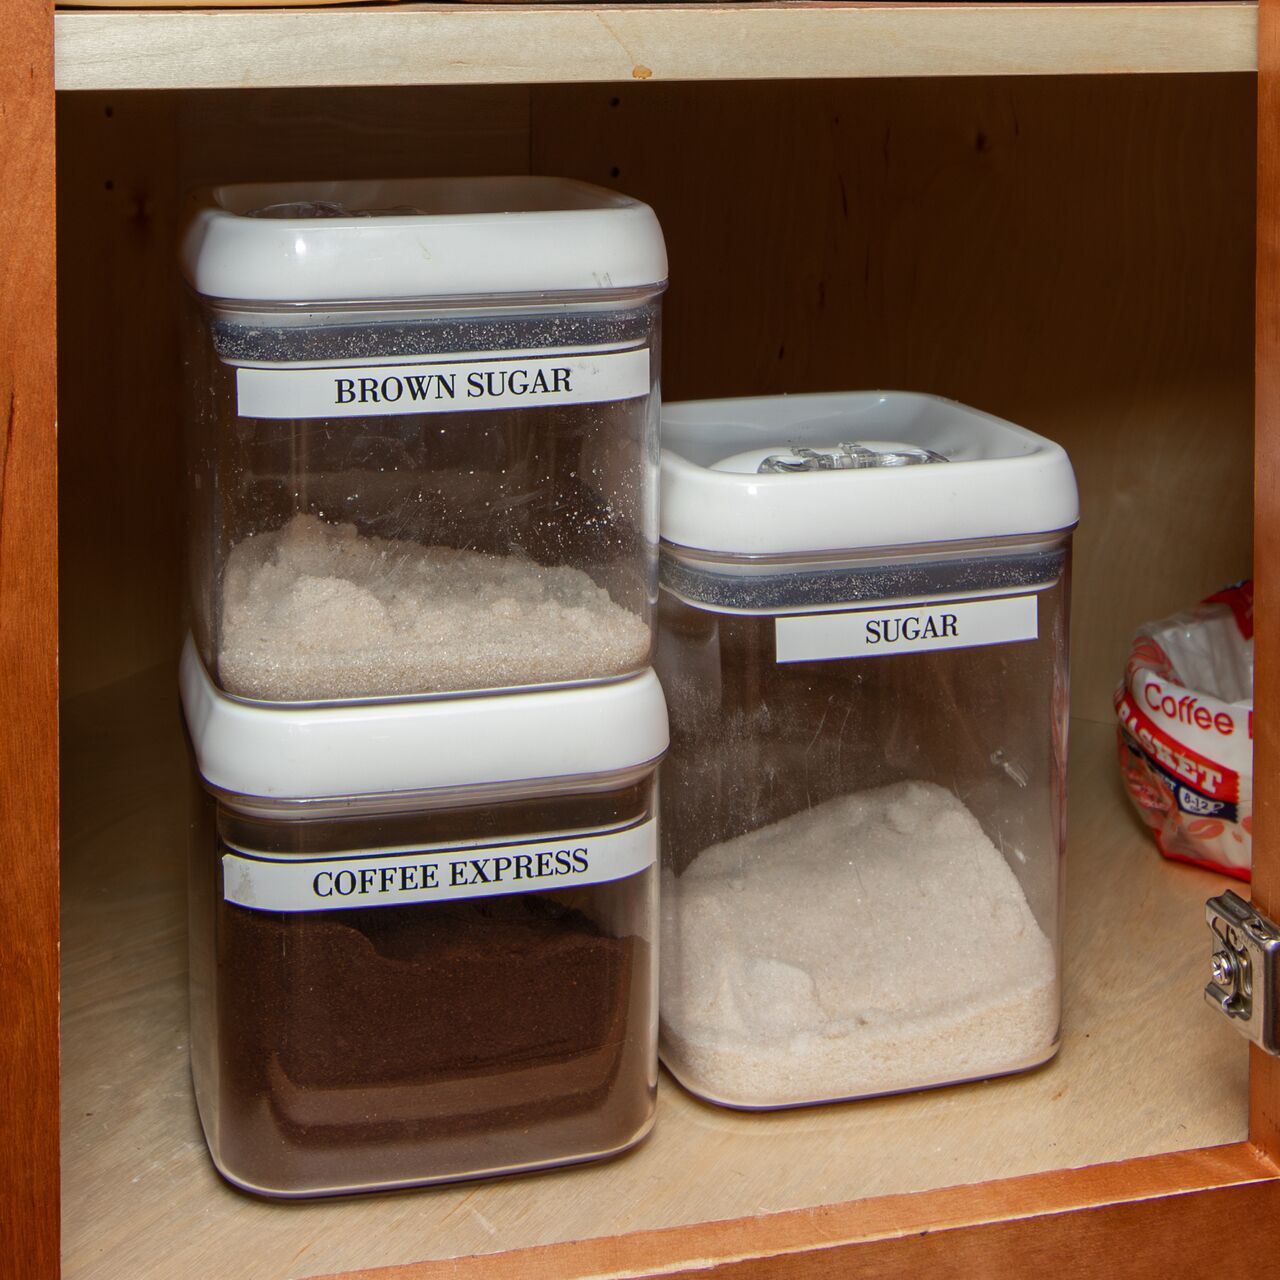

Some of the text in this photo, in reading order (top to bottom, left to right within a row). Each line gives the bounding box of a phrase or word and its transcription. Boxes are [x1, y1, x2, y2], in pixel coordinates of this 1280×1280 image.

[334, 367, 573, 404] BROWN SUGAR
[865, 613, 959, 644] SUGAR
[1144, 683, 1234, 736] Coffee
[312, 847, 590, 898] COFFEE EXPRESS
